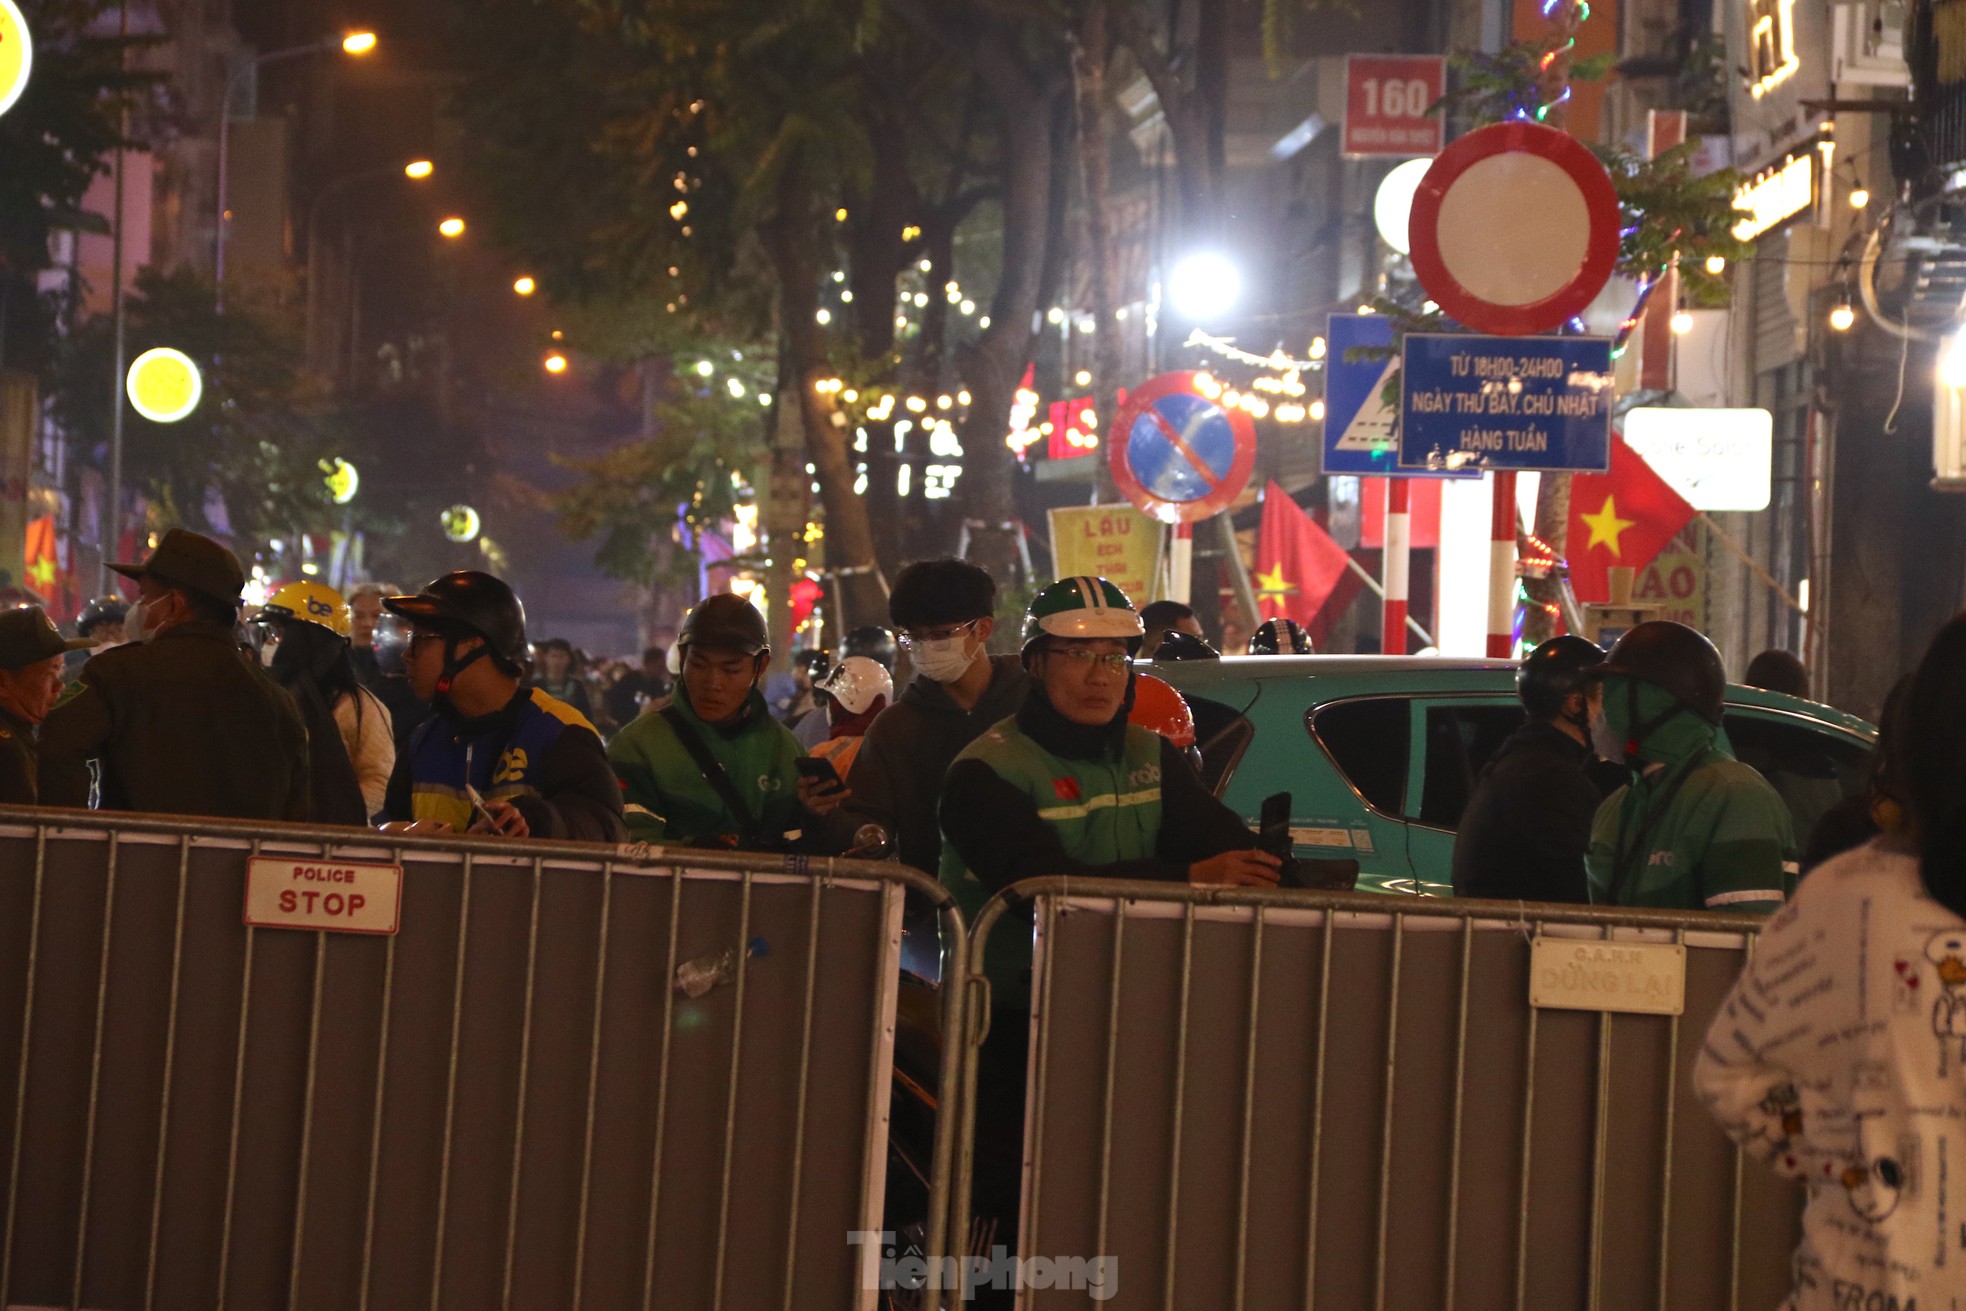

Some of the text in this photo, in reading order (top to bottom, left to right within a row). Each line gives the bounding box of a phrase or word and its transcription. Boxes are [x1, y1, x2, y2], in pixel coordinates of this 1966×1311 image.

[1361, 78, 1428, 118] 160
[1451, 351, 1472, 376] TỪ
[1412, 387, 1452, 412] NGÀY
[1524, 387, 1554, 415] CHỦ
[1460, 422, 1548, 451] HÀNG TUẦN
[307, 595, 333, 617] be
[293, 866, 355, 883] POLICE
[279, 889, 366, 917] STOP
